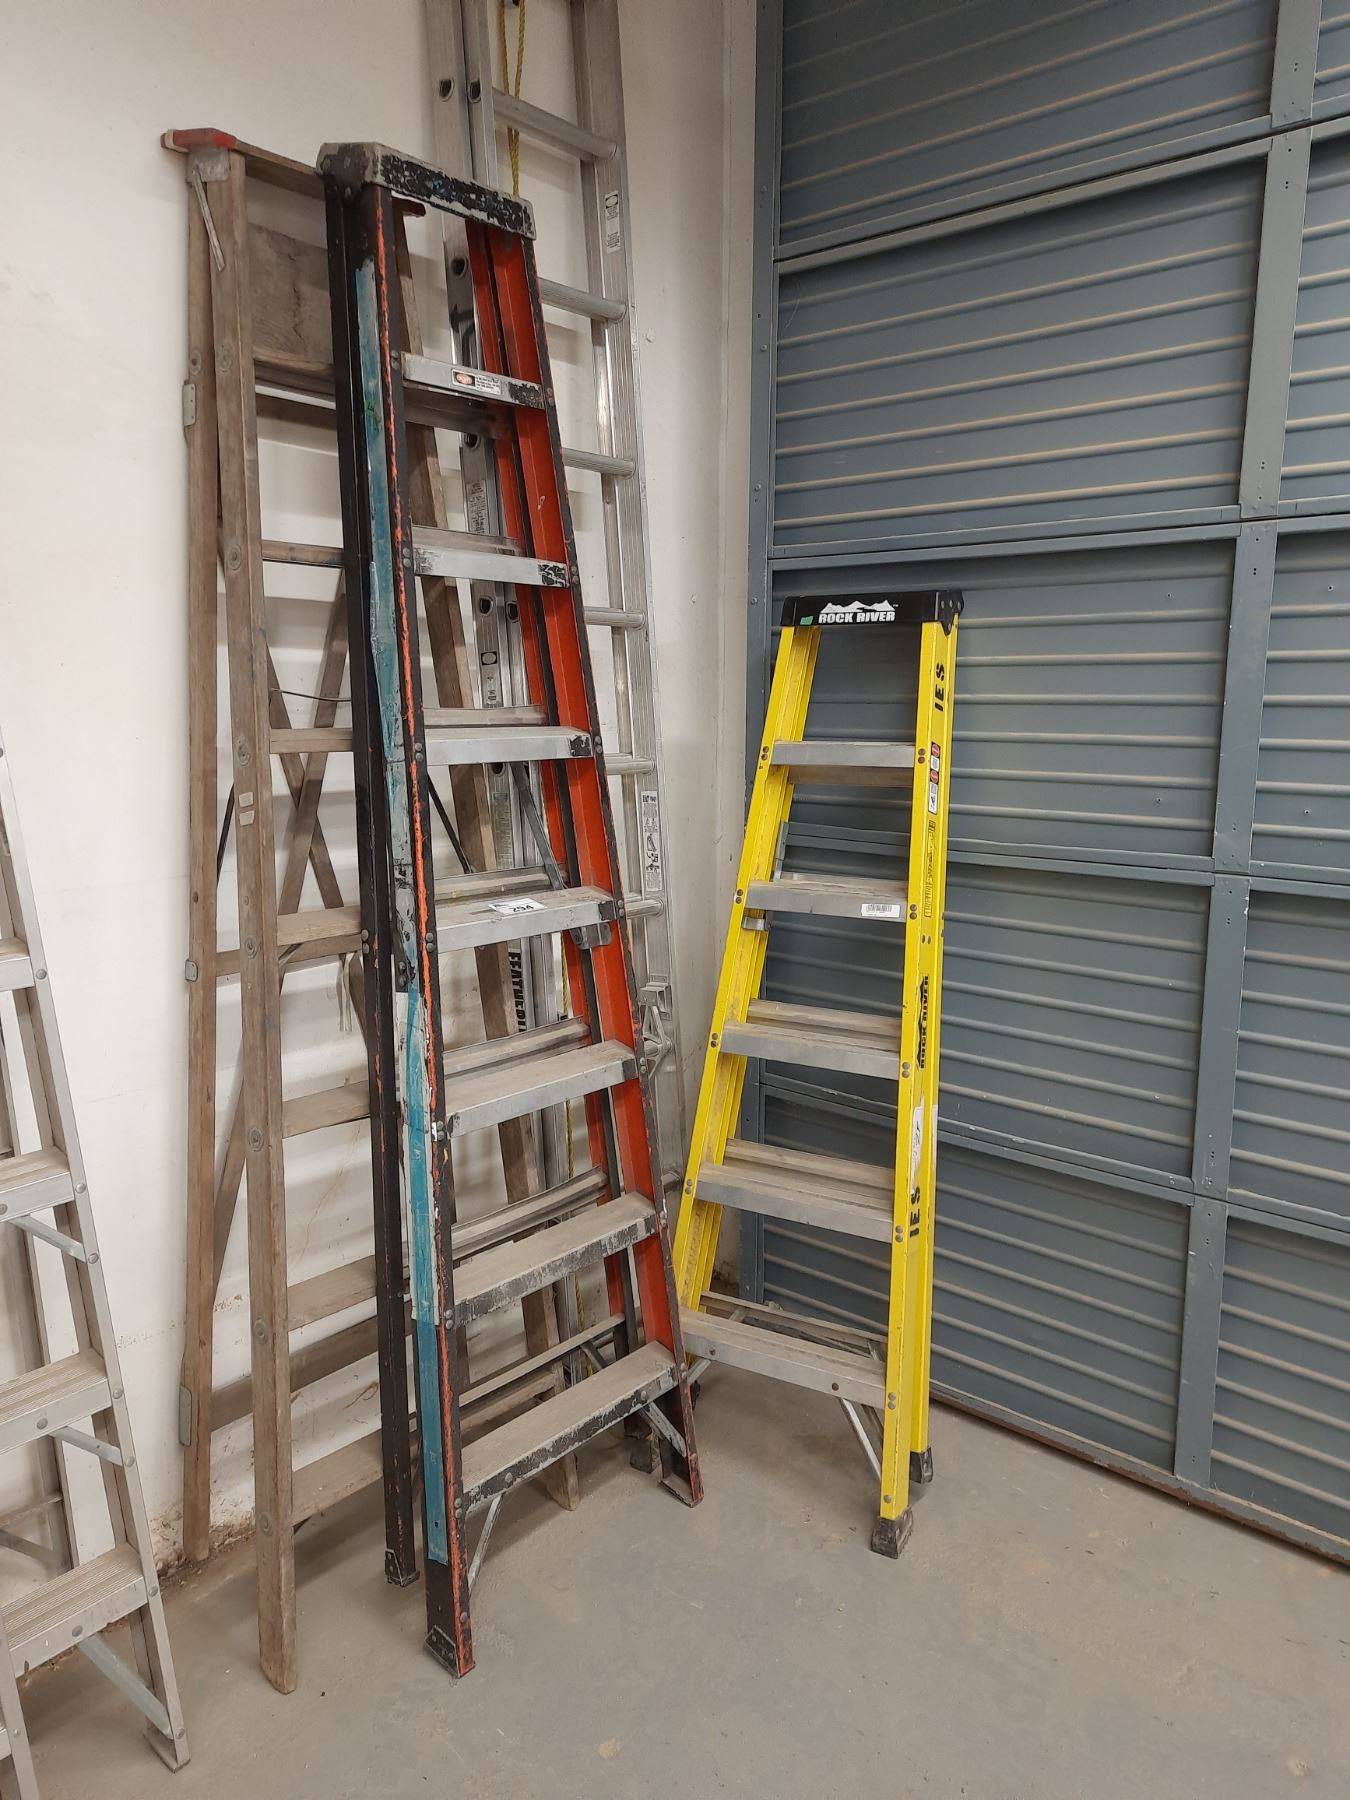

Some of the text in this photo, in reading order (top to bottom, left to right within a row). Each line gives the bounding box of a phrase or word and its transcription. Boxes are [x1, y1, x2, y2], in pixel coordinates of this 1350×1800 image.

[818, 611, 895, 624] ROCK RIVER
[934, 663, 945, 711] IES
[910, 1186, 920, 1238] IES
